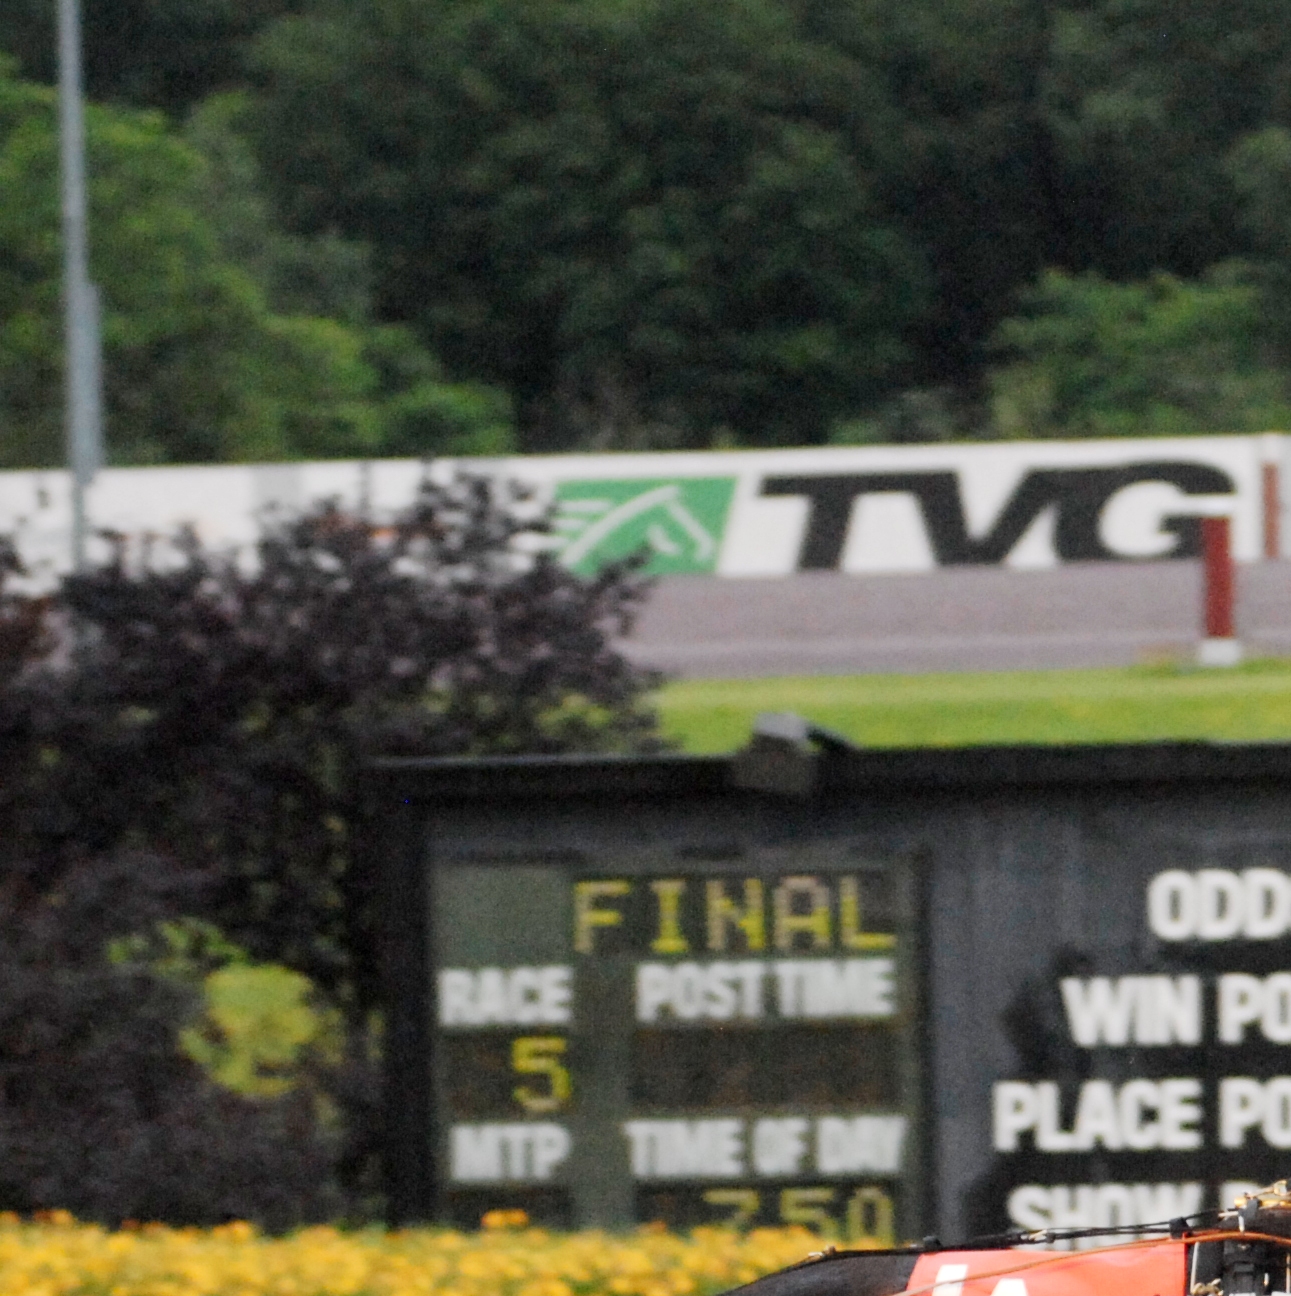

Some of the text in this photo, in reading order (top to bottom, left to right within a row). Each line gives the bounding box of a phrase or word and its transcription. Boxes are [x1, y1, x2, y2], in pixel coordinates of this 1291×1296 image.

[759, 460, 1235, 570] TVG
[574, 874, 898, 954] FINAL
[438, 965, 573, 1027] RACE
[635, 958, 896, 1024] POST TIME
[1061, 974, 1201, 1048] WIN
[512, 1036, 572, 1113] 5
[452, 1121, 572, 1181] MTP
[623, 1115, 905, 1178] TIME OF DAY
[992, 1078, 1202, 1152] PLACE
